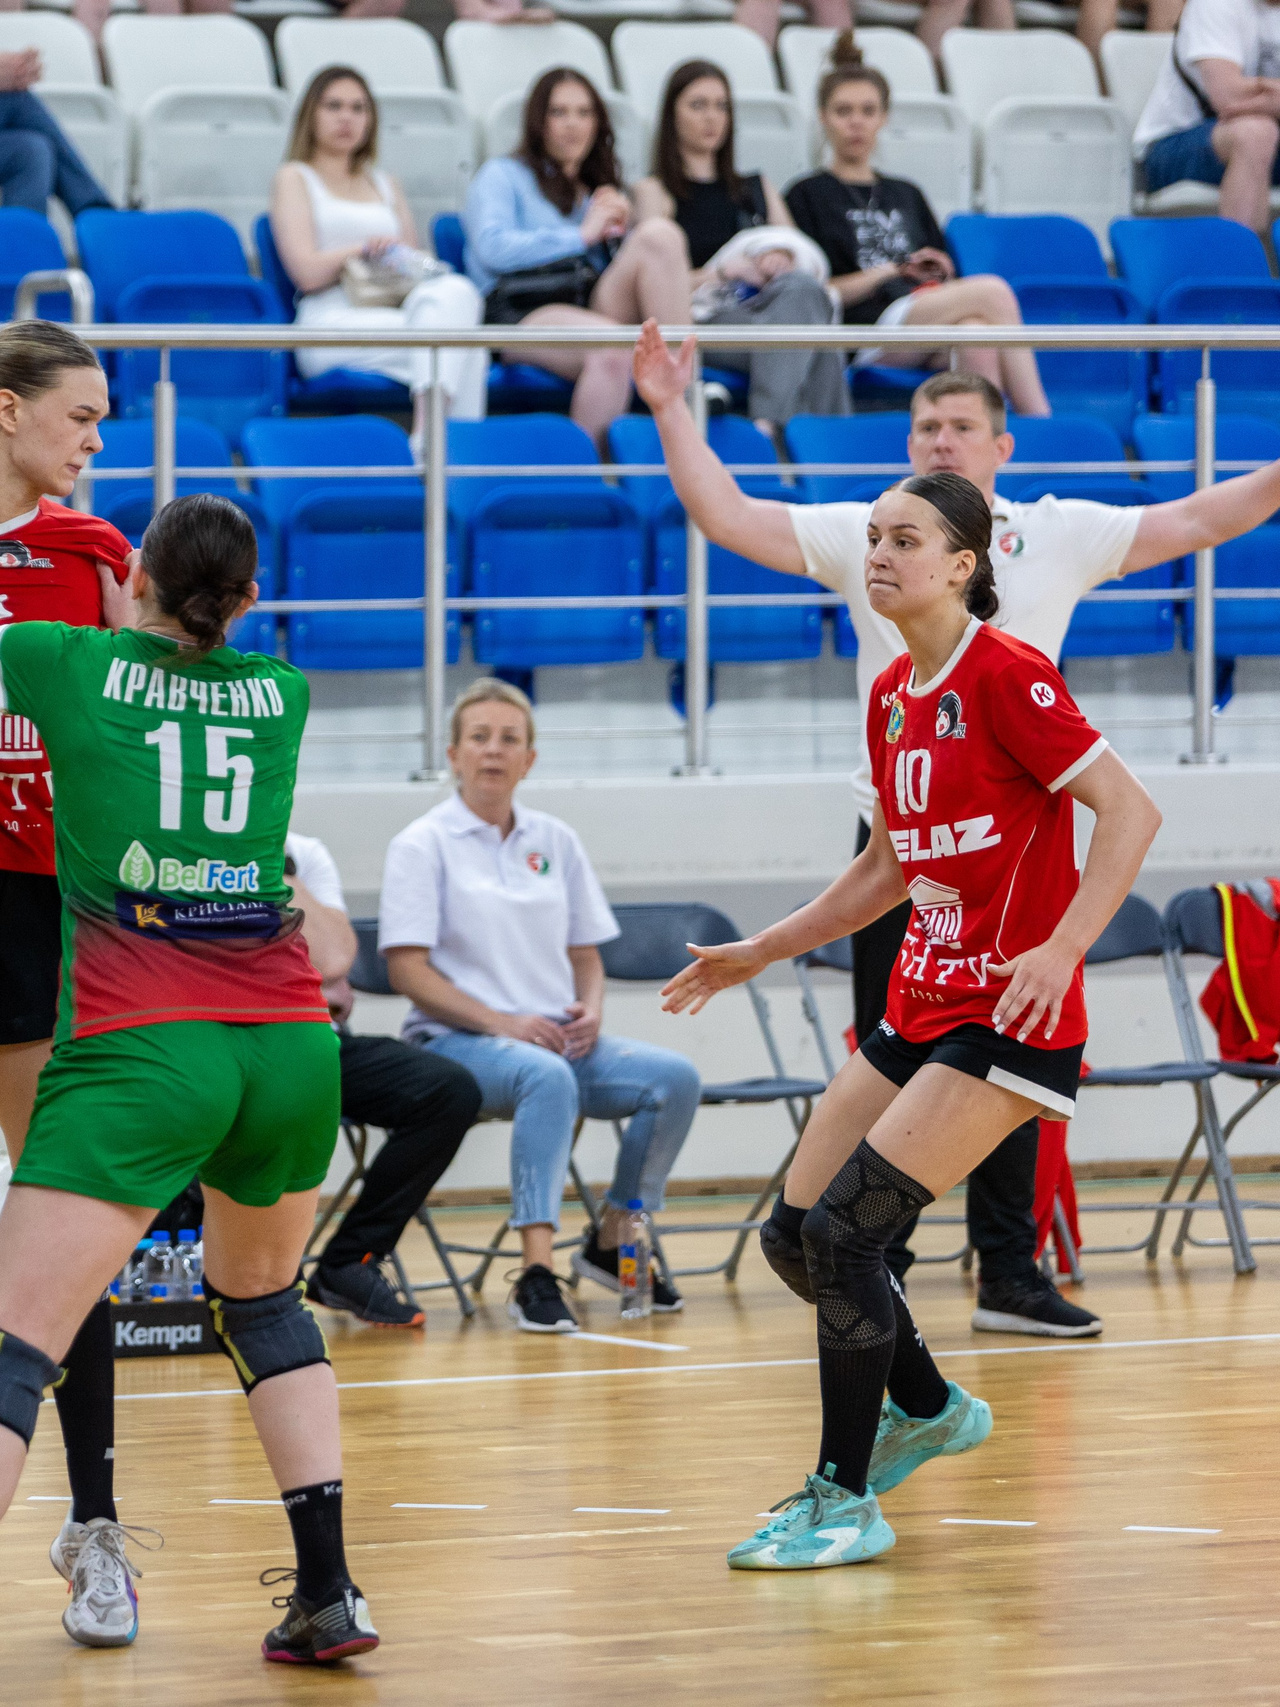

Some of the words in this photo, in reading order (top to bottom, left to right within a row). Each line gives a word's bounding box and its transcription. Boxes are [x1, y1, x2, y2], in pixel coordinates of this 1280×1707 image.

[102, 657, 284, 717] КРАВЧЕНКО
[145, 720, 255, 833] 15
[895, 748, 931, 815] 10
[888, 814, 1002, 862] ELAZ
[159, 857, 259, 892] BelFert
[115, 1320, 203, 1351] Kempa
